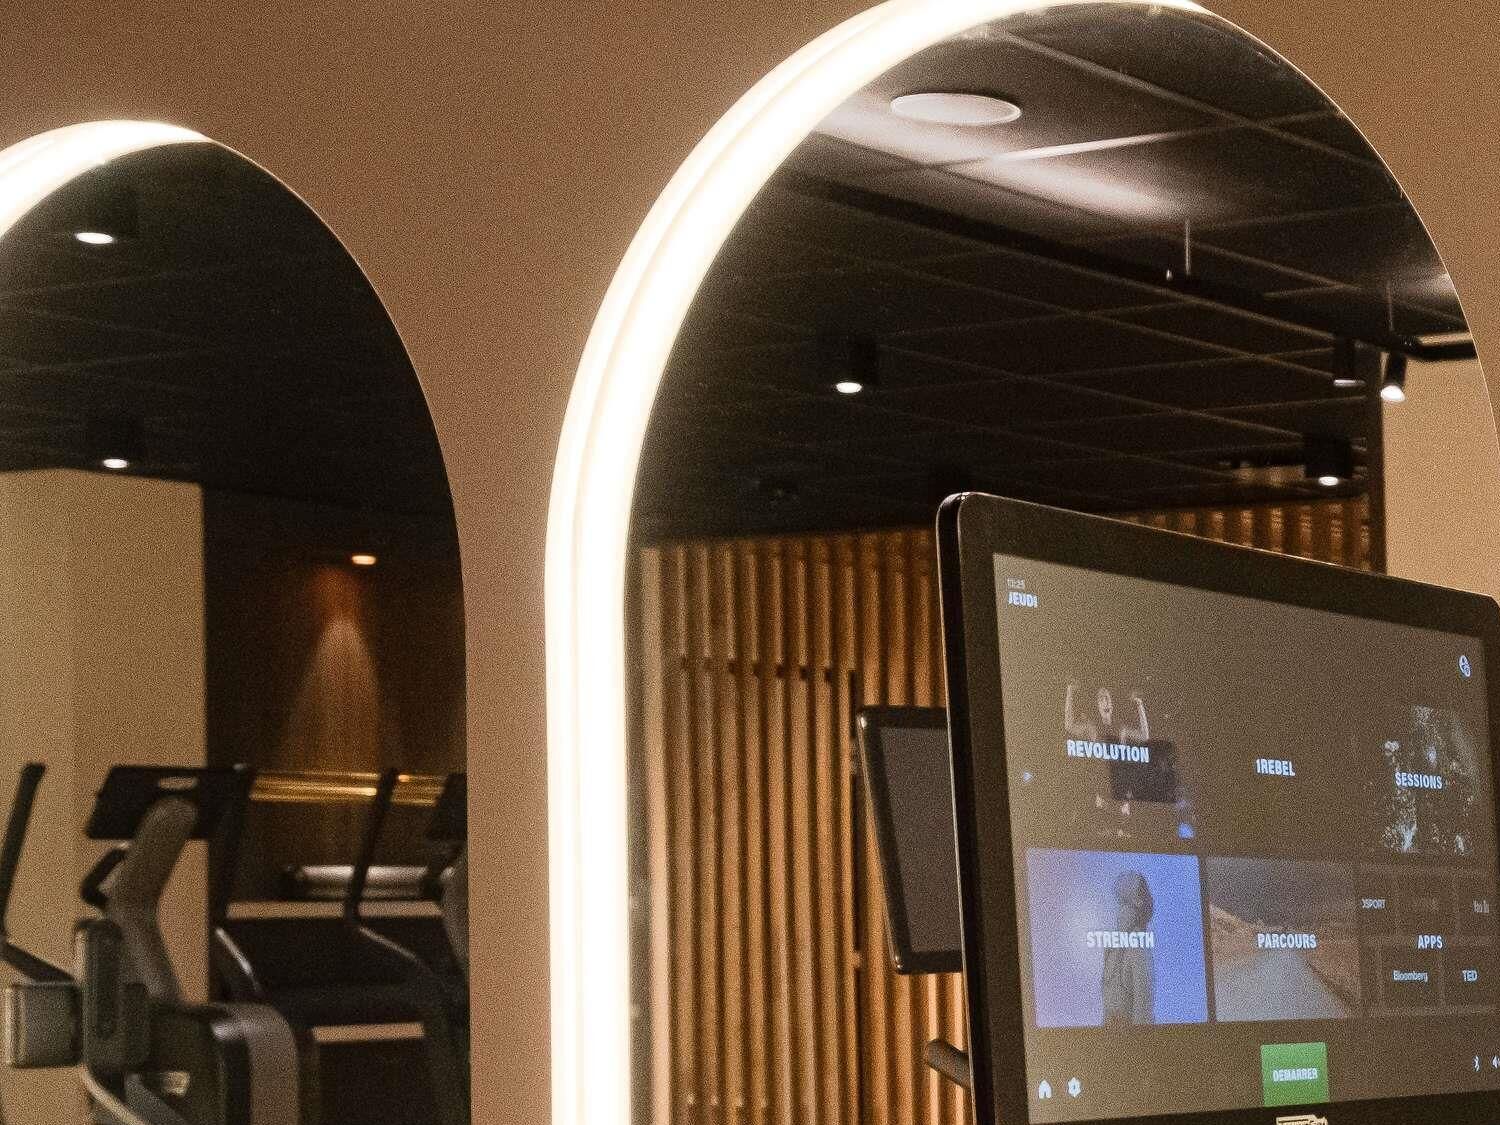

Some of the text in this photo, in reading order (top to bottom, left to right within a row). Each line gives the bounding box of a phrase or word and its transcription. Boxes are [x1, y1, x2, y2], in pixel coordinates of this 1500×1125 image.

[1008, 591, 1038, 608] JEUDI
[1067, 740, 1149, 762] REVOLUTION
[1395, 771, 1442, 789] SESSIONS
[1087, 931, 1154, 948] STRENGTH
[1257, 933, 1317, 948] PARCOURS
[1417, 934, 1443, 949] APPS
[1462, 970, 1478, 981] TED
